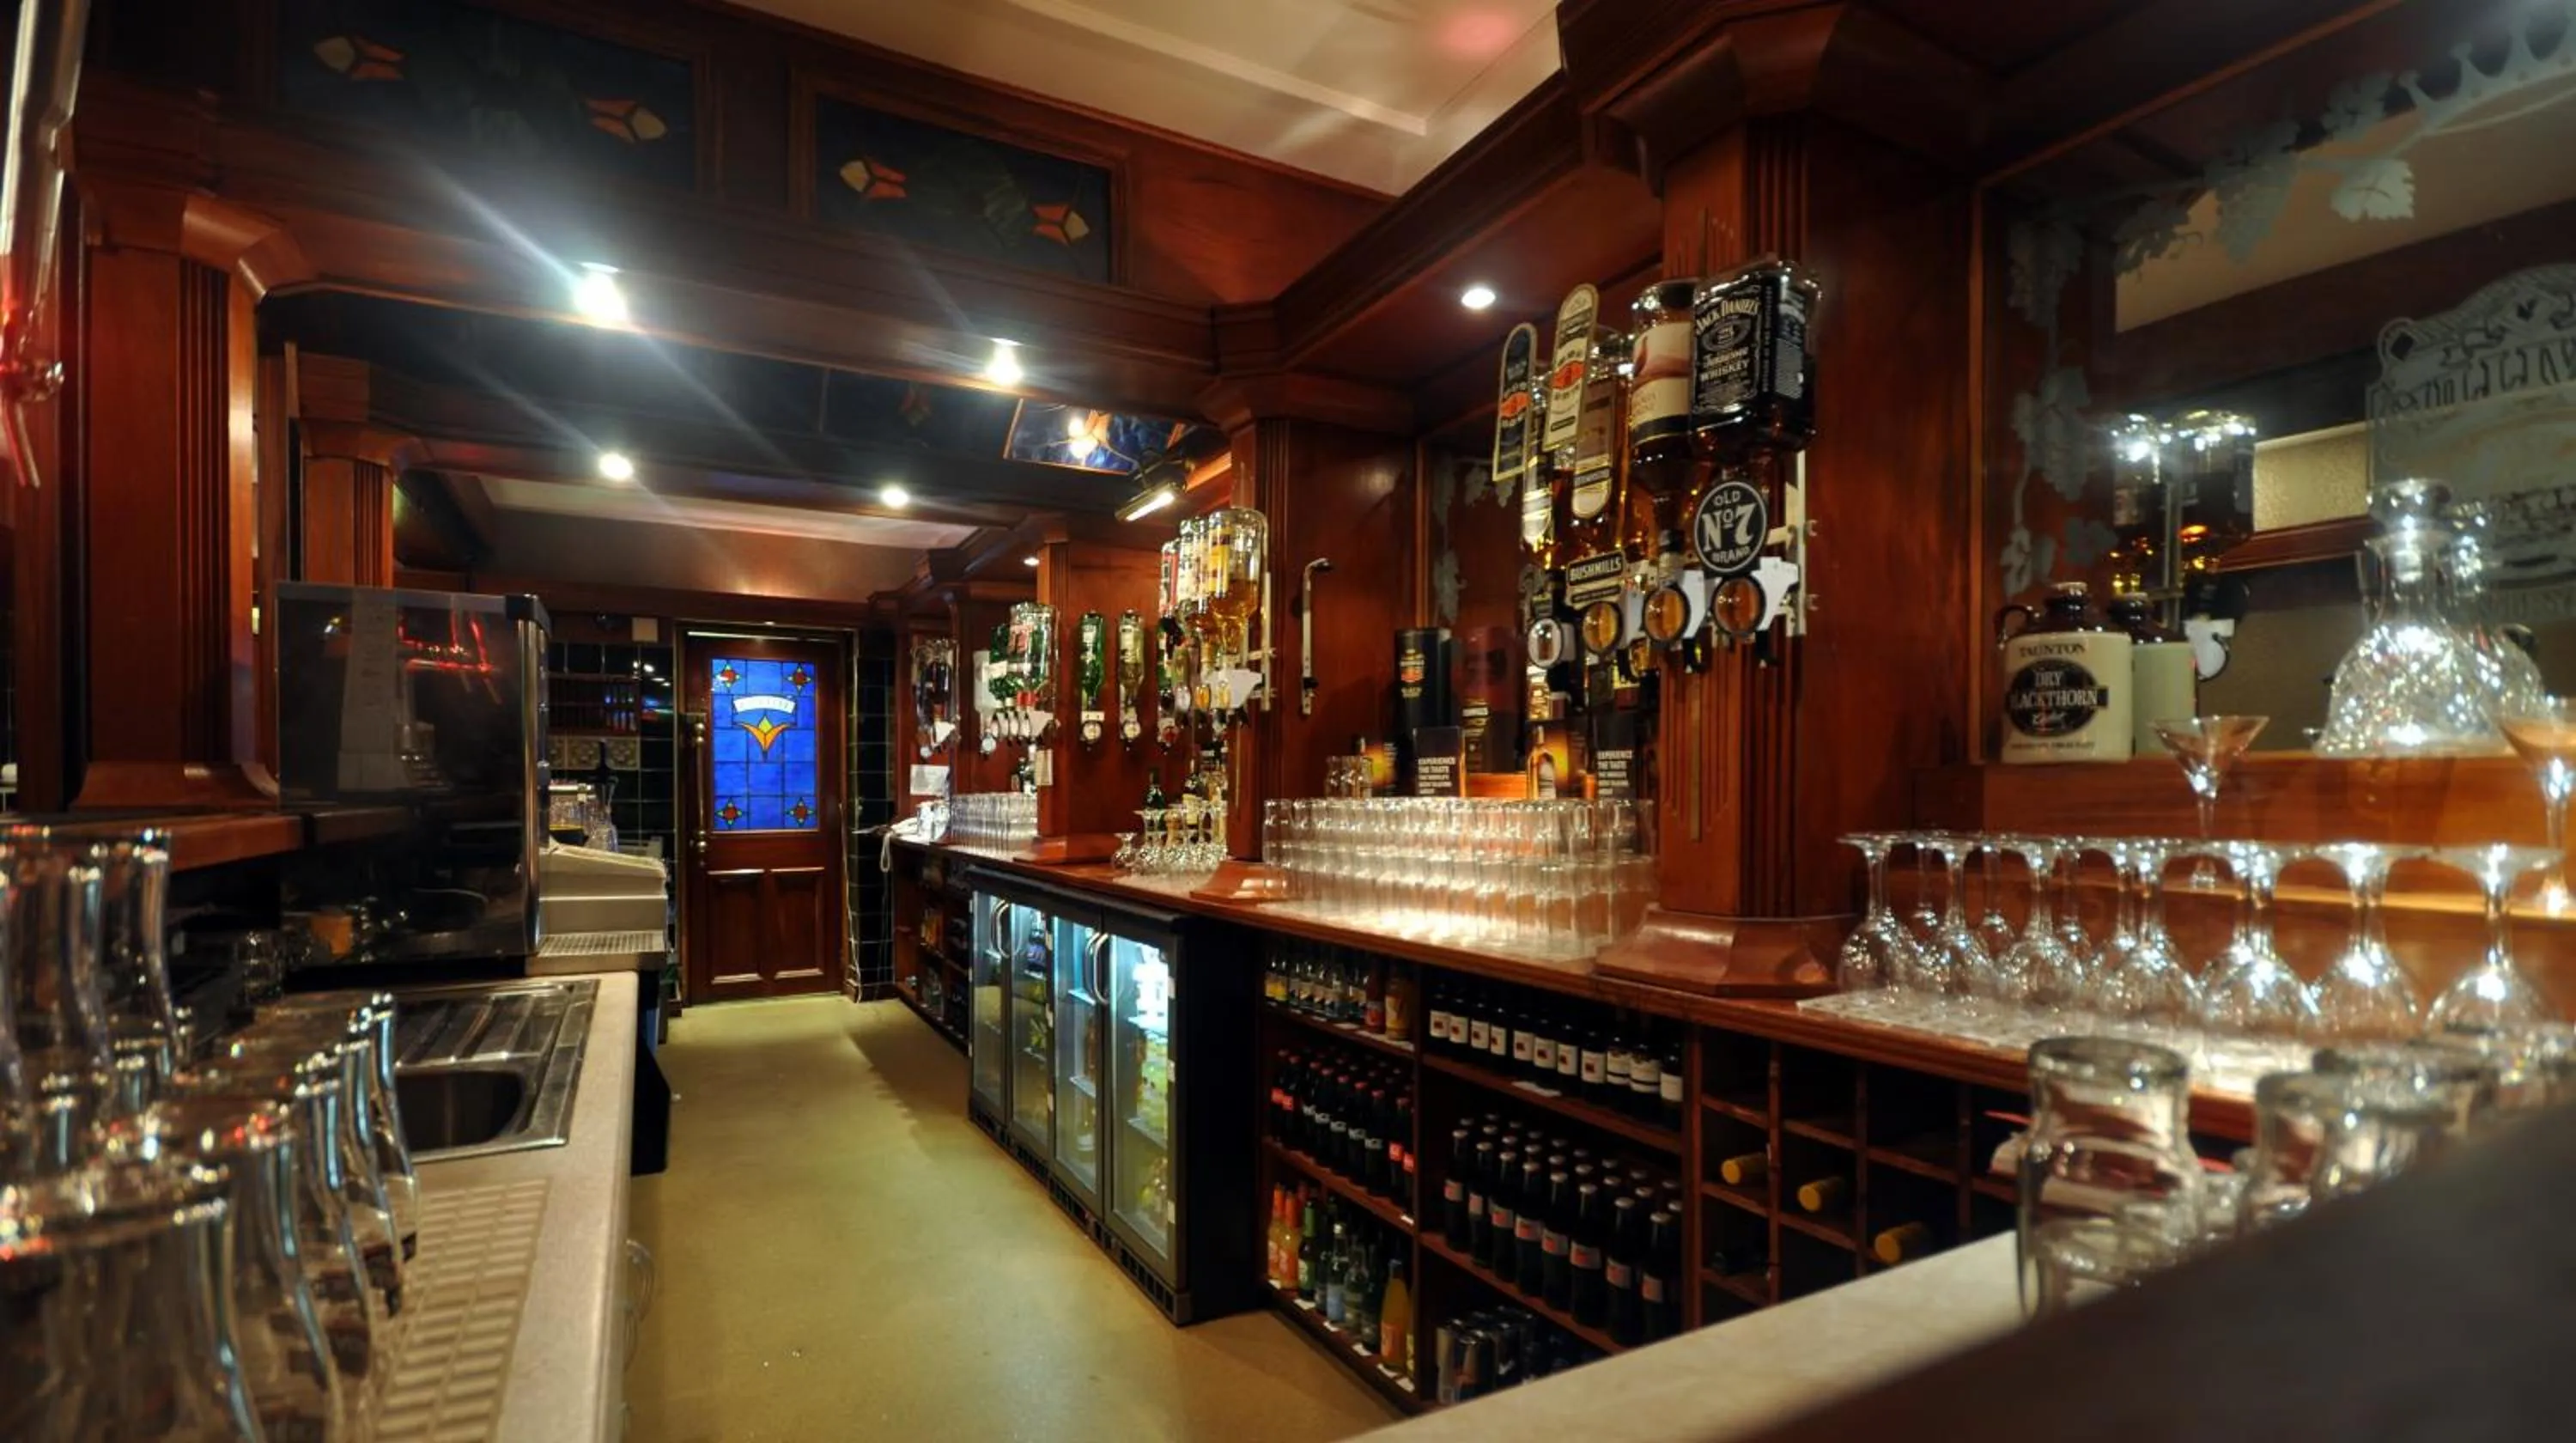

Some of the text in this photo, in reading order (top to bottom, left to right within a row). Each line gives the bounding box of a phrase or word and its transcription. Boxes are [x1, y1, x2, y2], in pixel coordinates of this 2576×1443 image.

[1696, 309, 1721, 336] JACK
[1700, 359, 1750, 382] WHISKEY
[1712, 490, 1741, 507] OLD
[1711, 545, 1751, 564] BRAND
[1570, 557, 1622, 581] BUSHMILLS
[2019, 642, 2086, 657] TAUNTON
[2033, 670, 2063, 686] DRY
